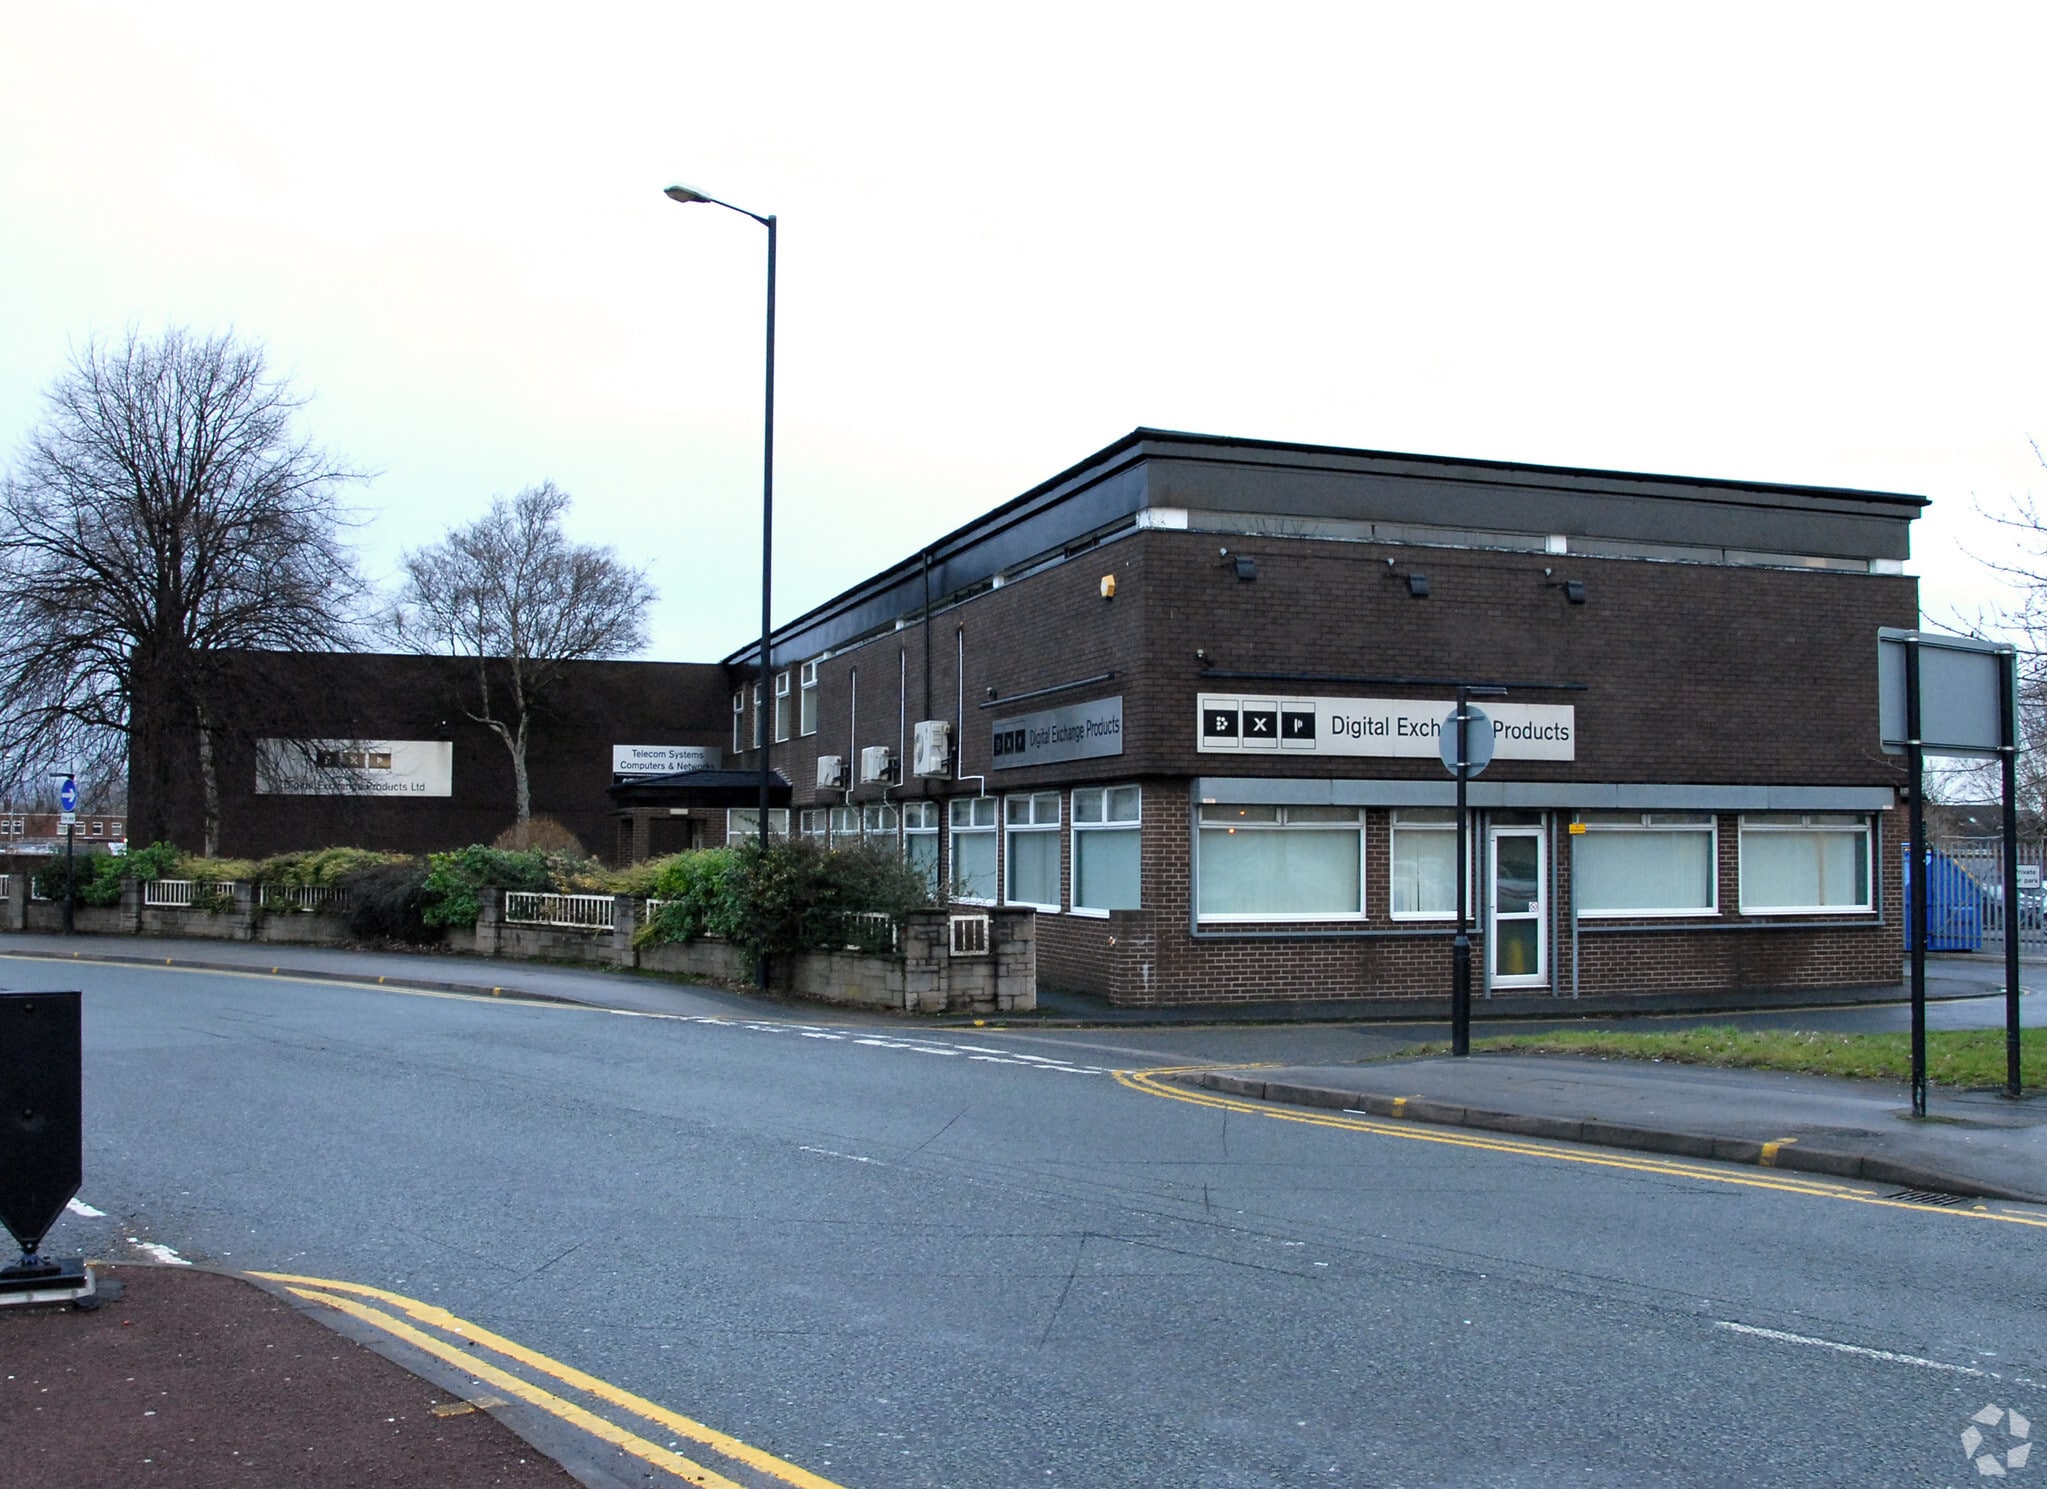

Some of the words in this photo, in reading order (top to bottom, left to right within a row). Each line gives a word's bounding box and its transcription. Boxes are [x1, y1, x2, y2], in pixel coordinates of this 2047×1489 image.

[1030, 725, 1050, 748] Digital
[1052, 724, 1084, 742] Exchange
[1086, 715, 1120, 737] Products
[1332, 715, 1389, 738] Digital
[1397, 717, 1440, 737] Exch
[1493, 720, 1569, 741] Products
[632, 749, 666, 758] Telecom
[669, 750, 704, 760] Systems
[620, 761, 666, 770] Computers
[367, 782, 408, 791] Products
[411, 782, 425, 791] Ltd
